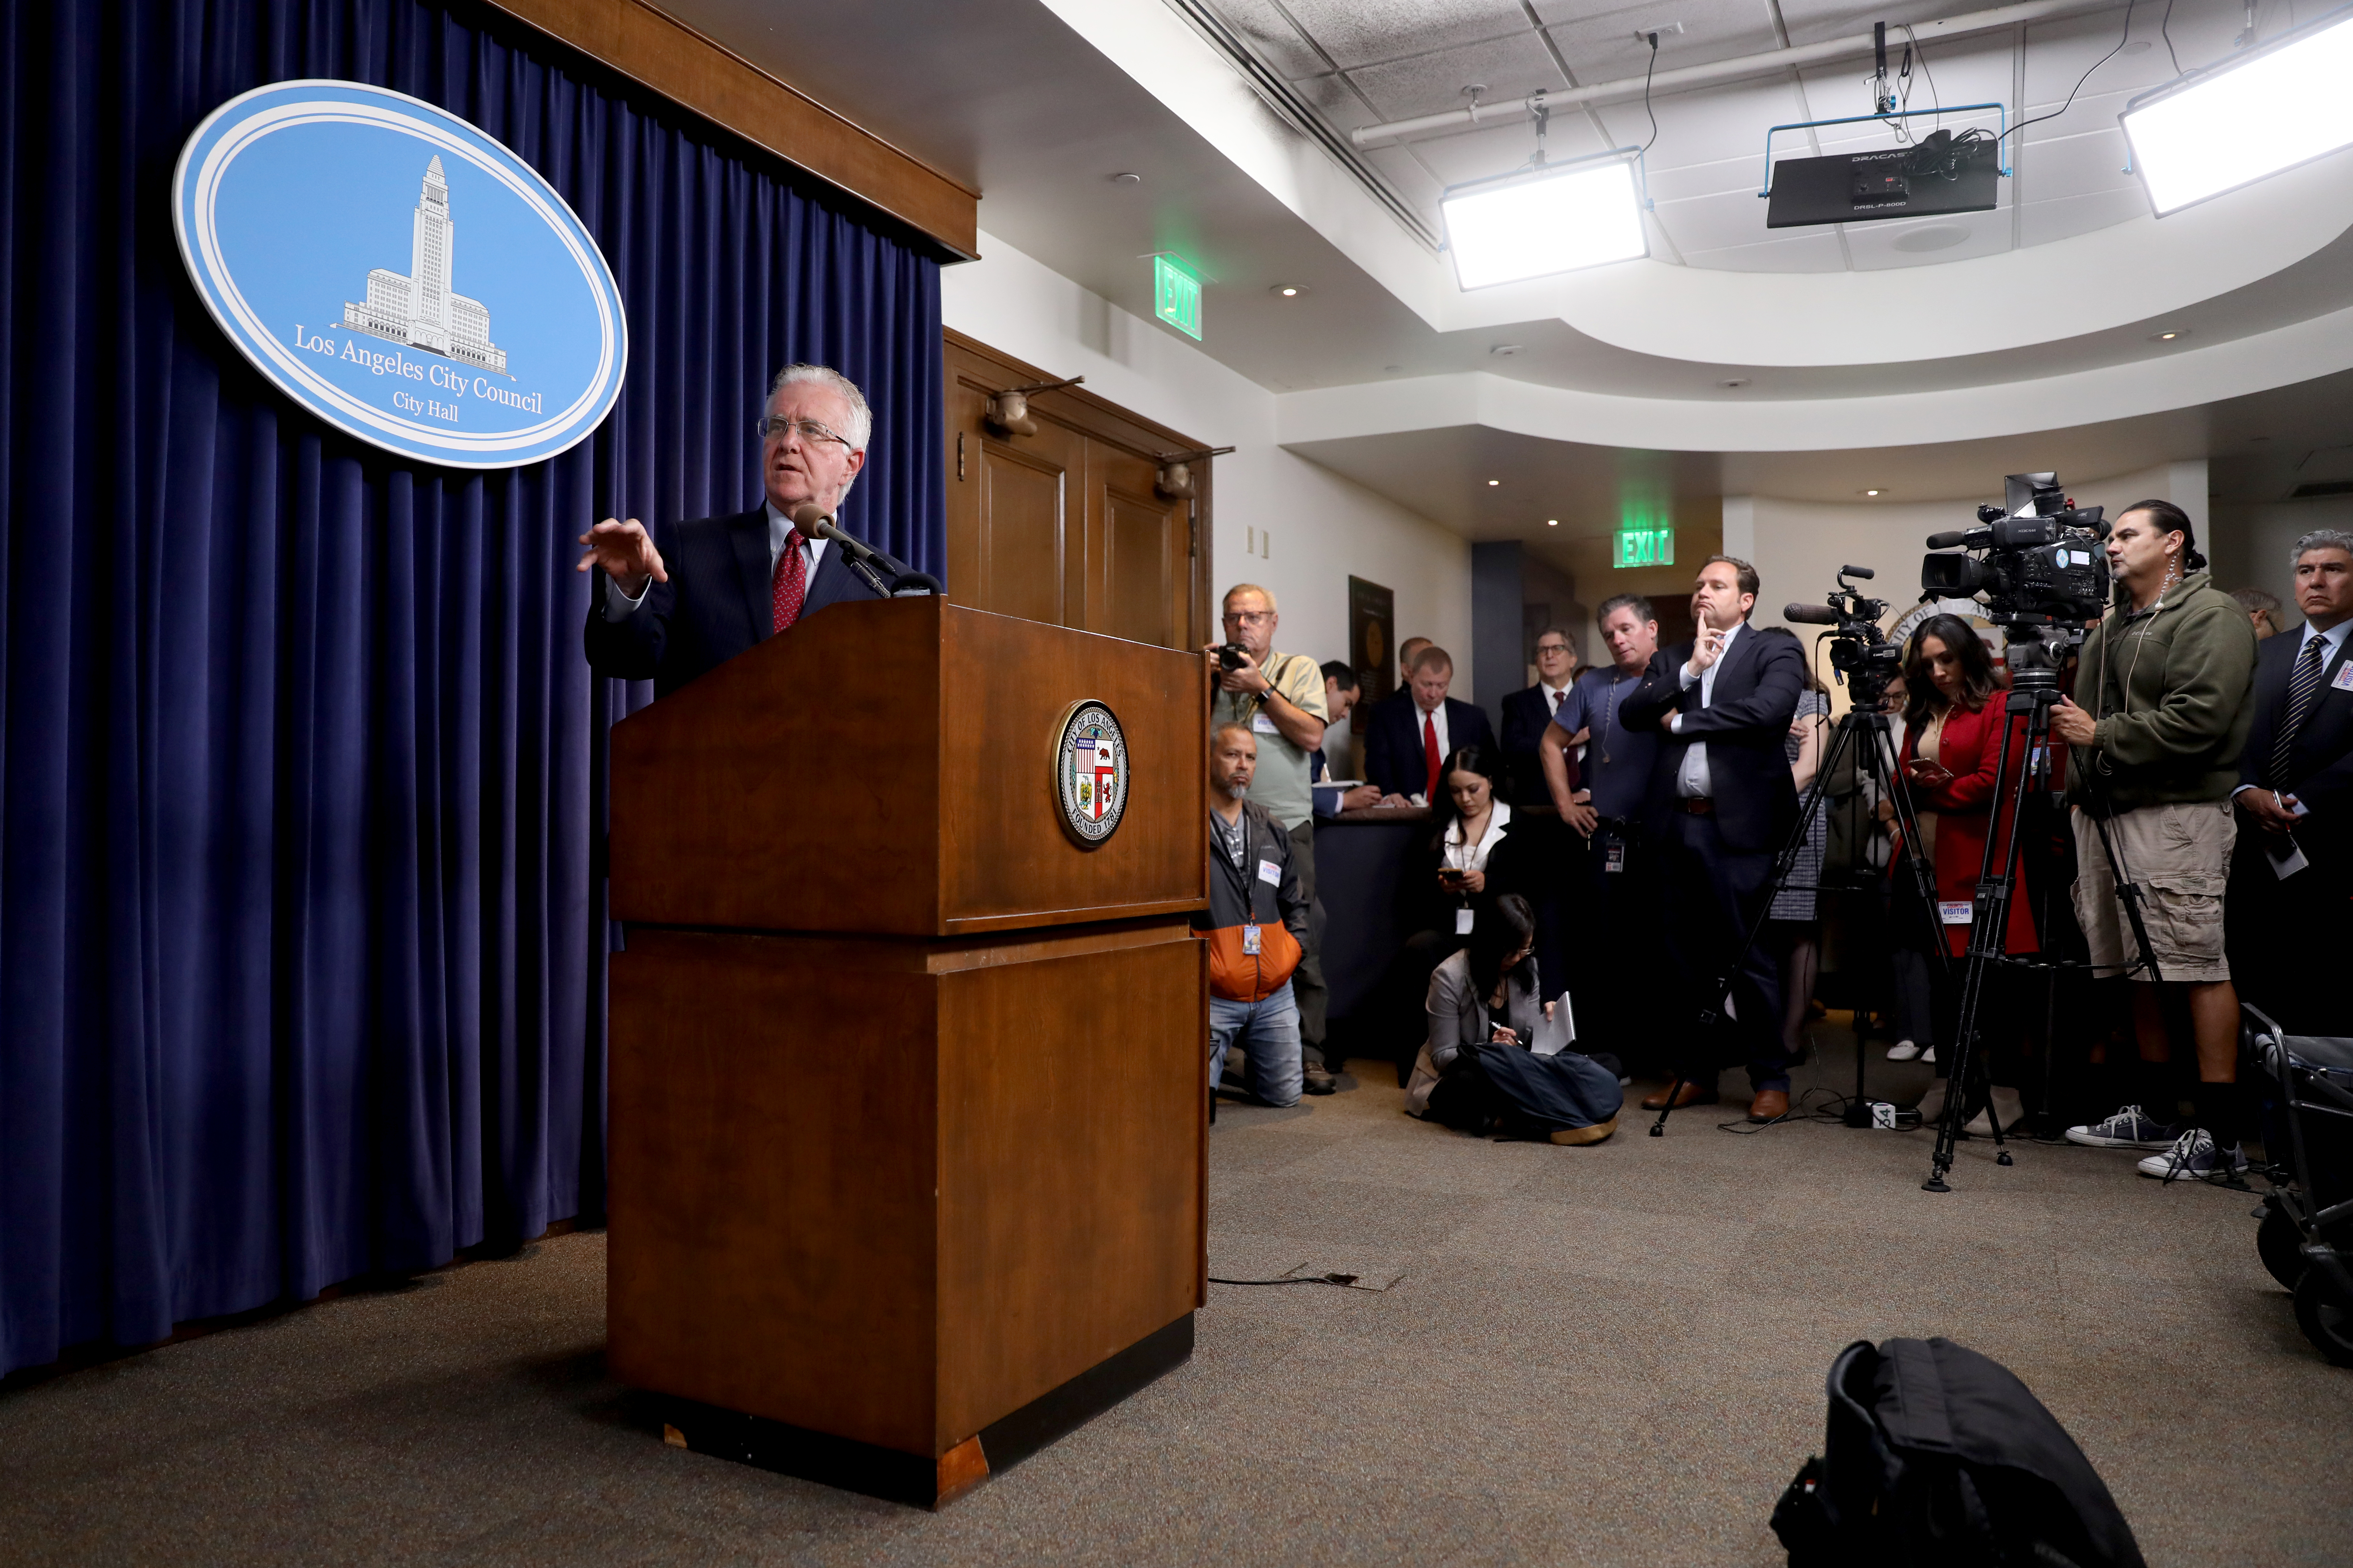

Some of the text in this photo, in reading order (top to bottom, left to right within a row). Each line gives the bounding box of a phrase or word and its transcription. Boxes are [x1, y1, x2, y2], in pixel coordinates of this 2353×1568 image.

[1164, 265, 1198, 330] EXIT
[295, 324, 542, 414] Los Angeles City Council
[393, 391, 459, 422] City Hall
[1623, 530, 1668, 563] EXIT
[1067, 713, 1122, 757] CITY OF LOS ANGELES
[1072, 808, 1117, 834] FOUNDED 1781
